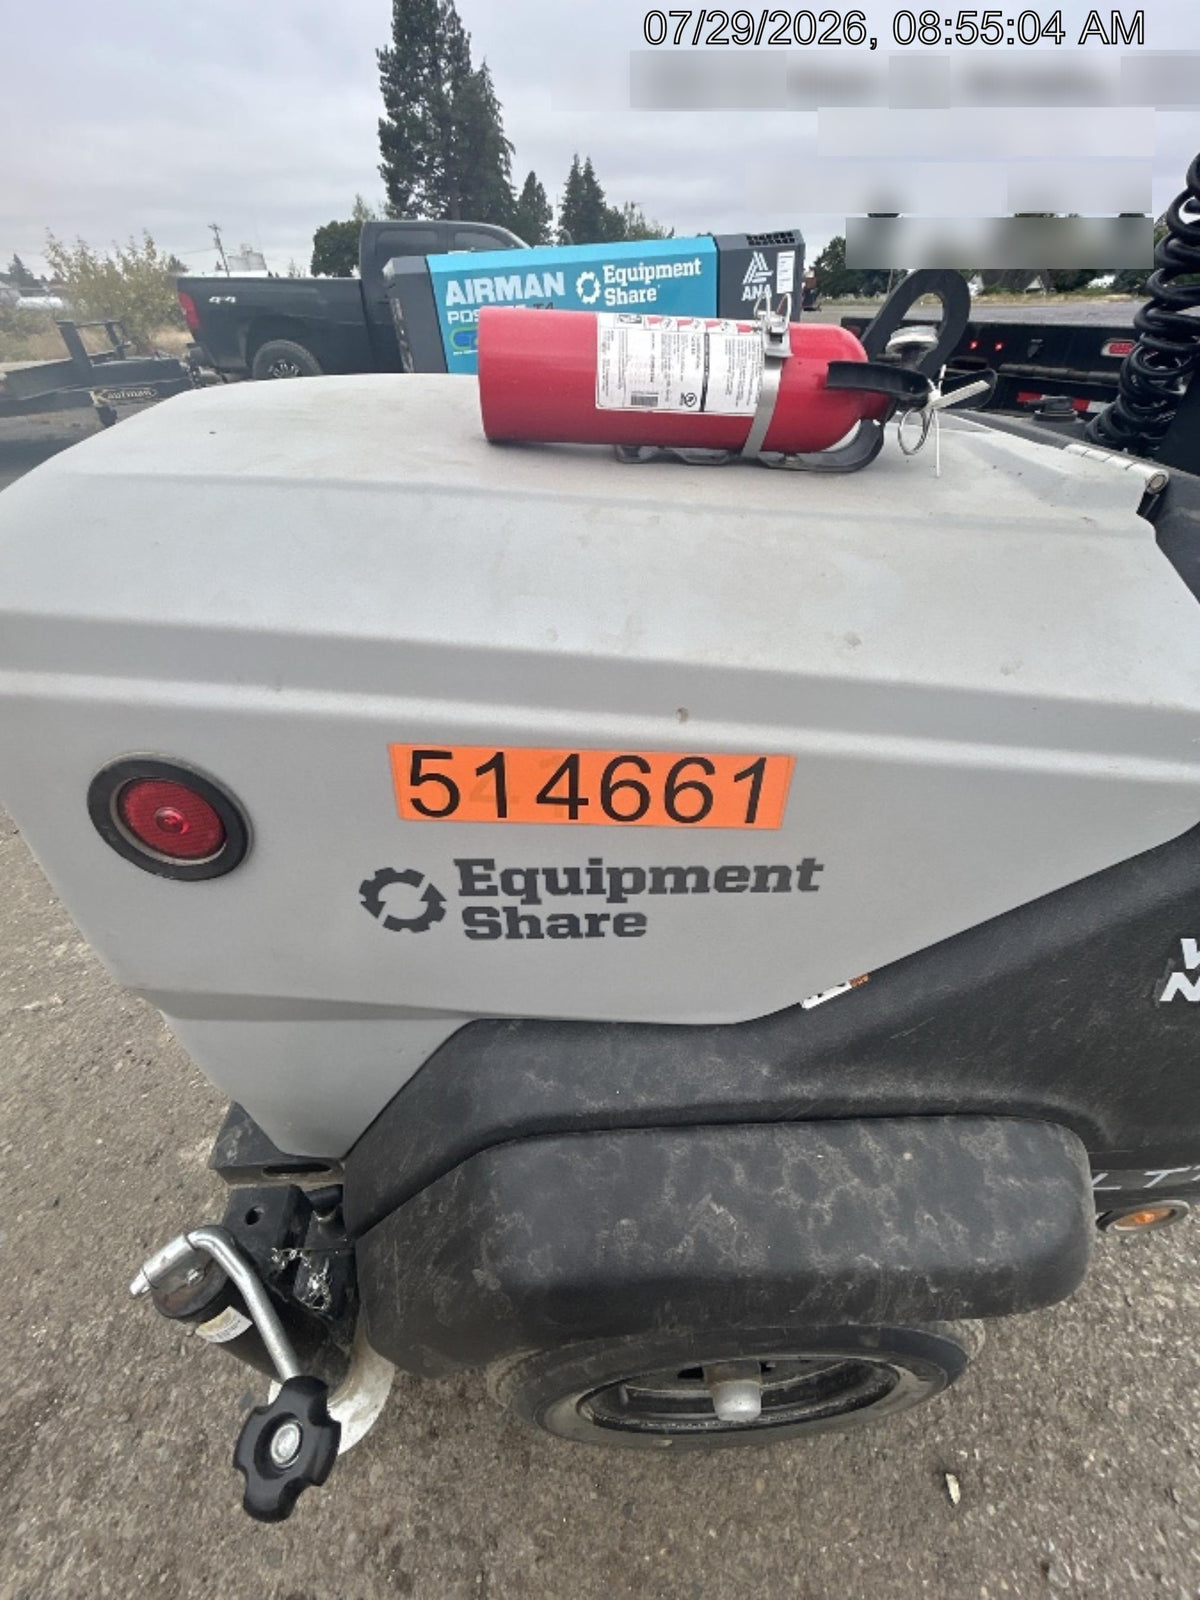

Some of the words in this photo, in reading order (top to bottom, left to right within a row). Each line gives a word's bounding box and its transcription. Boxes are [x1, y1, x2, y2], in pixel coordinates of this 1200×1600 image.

[603, 257, 702, 286] Equipment
[446, 271, 566, 307] AIRMAN
[604, 287, 658, 306] Share
[741, 284, 772, 301] ANA
[410, 749, 767, 824] 514661
[453, 857, 824, 905] Equipment
[461, 906, 648, 940] Share
